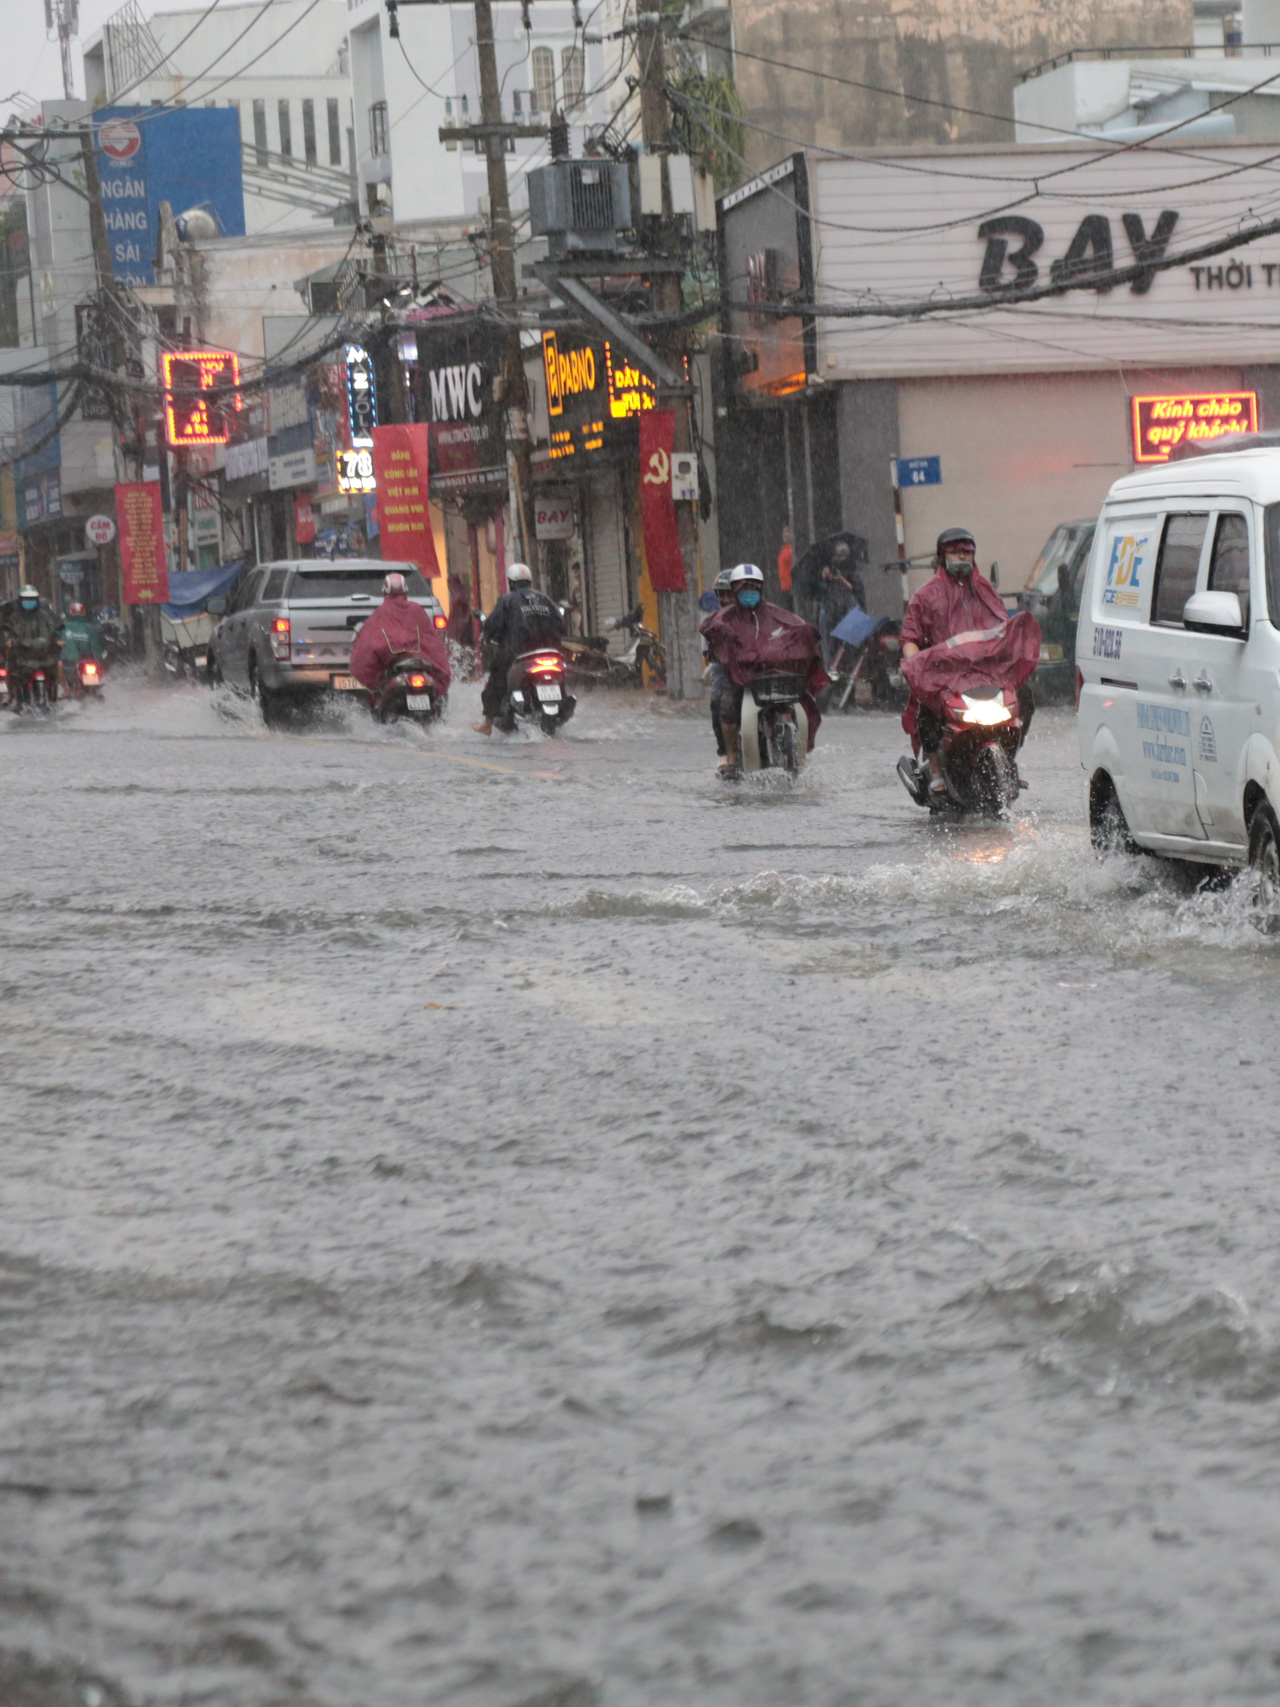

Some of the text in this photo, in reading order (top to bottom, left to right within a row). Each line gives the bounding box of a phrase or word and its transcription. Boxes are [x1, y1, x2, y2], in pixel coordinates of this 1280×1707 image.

[101, 175, 145, 198] NGÂN
[104, 208, 148, 231] HÀNG
[115, 240, 141, 262] SÀI
[978, 209, 1180, 295] BAY
[1190, 257, 1253, 291] THỜI
[559, 346, 596, 397] PABNO
[429, 362, 483, 423] MWC
[1151, 397, 1243, 418] Kính chào
[1147, 420, 1186, 445] quý
[343, 452, 372, 477] 78
[537, 509, 569, 524] BAY
